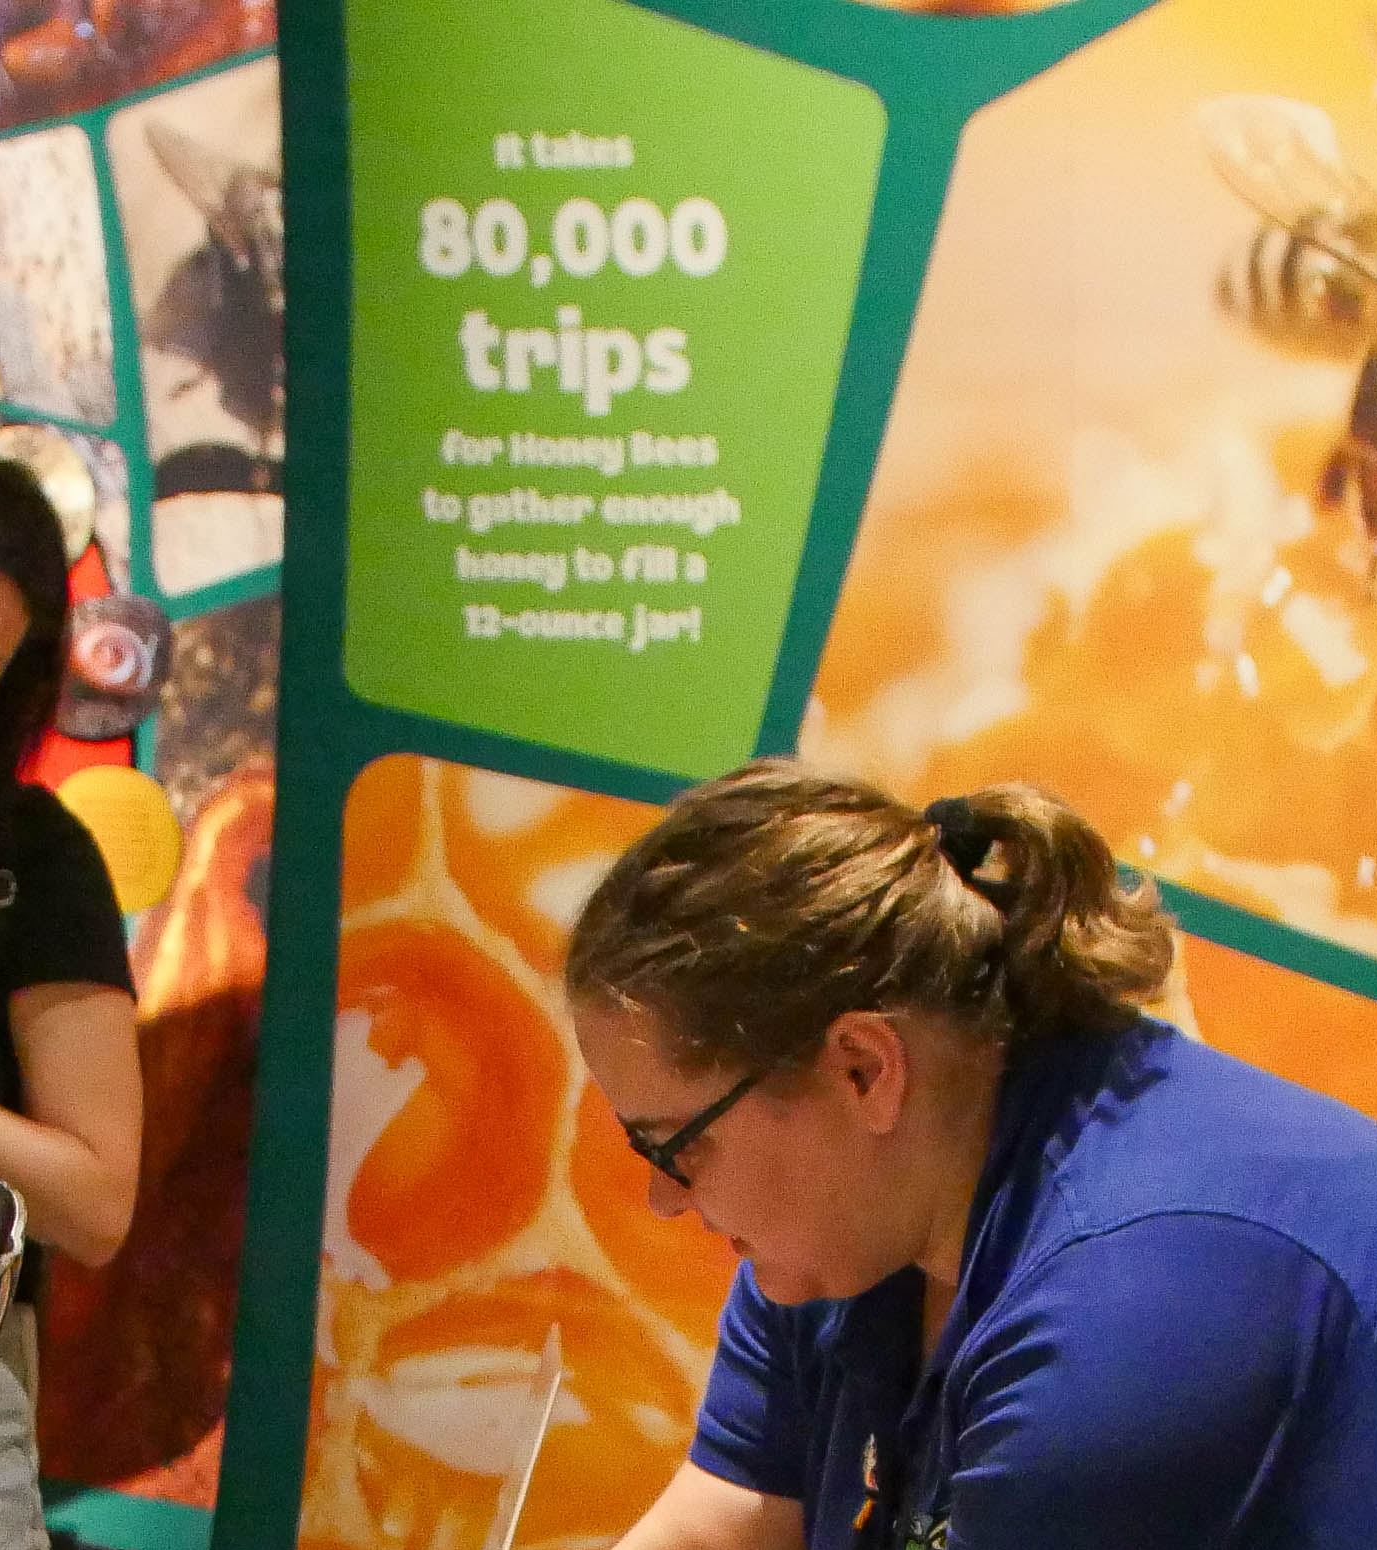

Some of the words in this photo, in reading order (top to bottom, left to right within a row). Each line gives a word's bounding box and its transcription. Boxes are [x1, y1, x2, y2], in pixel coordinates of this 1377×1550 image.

[530, 131, 634, 169] takes
[420, 197, 729, 288] 80,000
[459, 305, 692, 417] trips
[440, 429, 503, 467] for
[508, 432, 625, 478] Honey
[629, 432, 720, 468] Bees
[422, 488, 462, 523] to
[466, 488, 596, 534] gather
[600, 489, 741, 536] enough
[454, 546, 567, 592] honey
[572, 547, 615, 583] to
[620, 545, 678, 583] fill
[683, 552, 708, 584] a
[463, 605, 626, 641] 12-ounce
